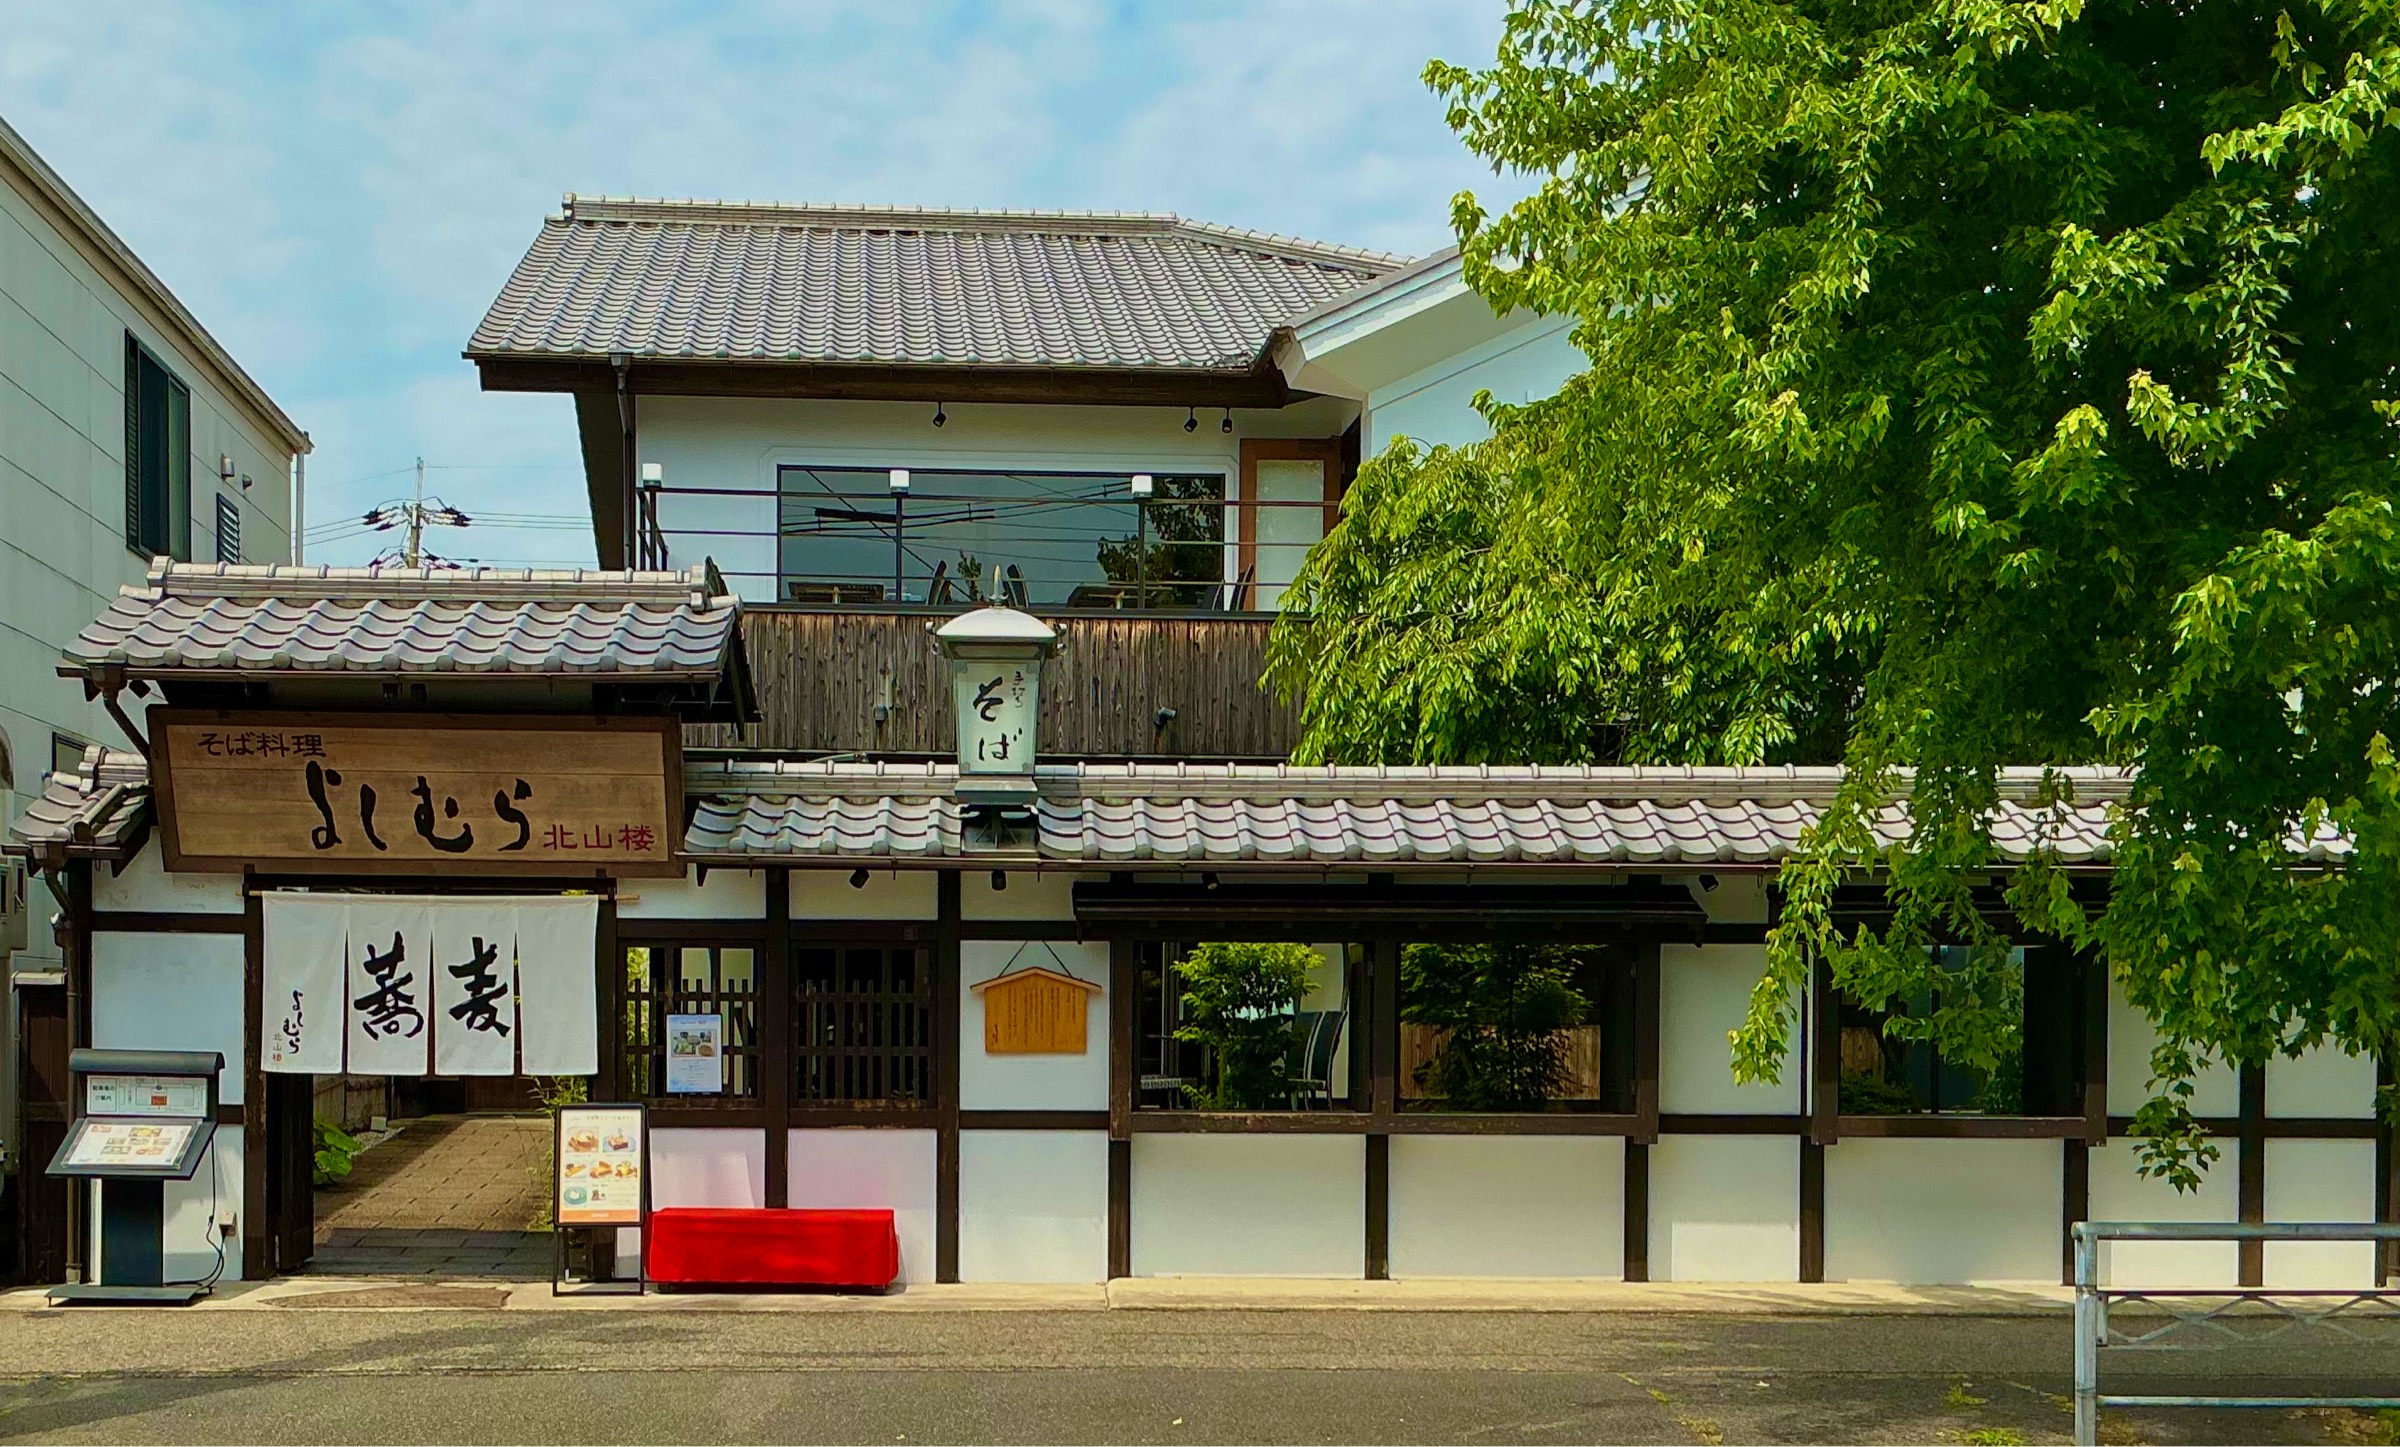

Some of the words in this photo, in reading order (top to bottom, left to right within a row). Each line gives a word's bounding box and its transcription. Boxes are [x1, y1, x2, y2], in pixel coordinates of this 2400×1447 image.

[199, 732, 327, 758] そば料理
[973, 676, 1023, 761] そば
[305, 760, 533, 854] よしむら
[543, 824, 655, 852] 北山楼
[282, 989, 304, 1055] よしむら
